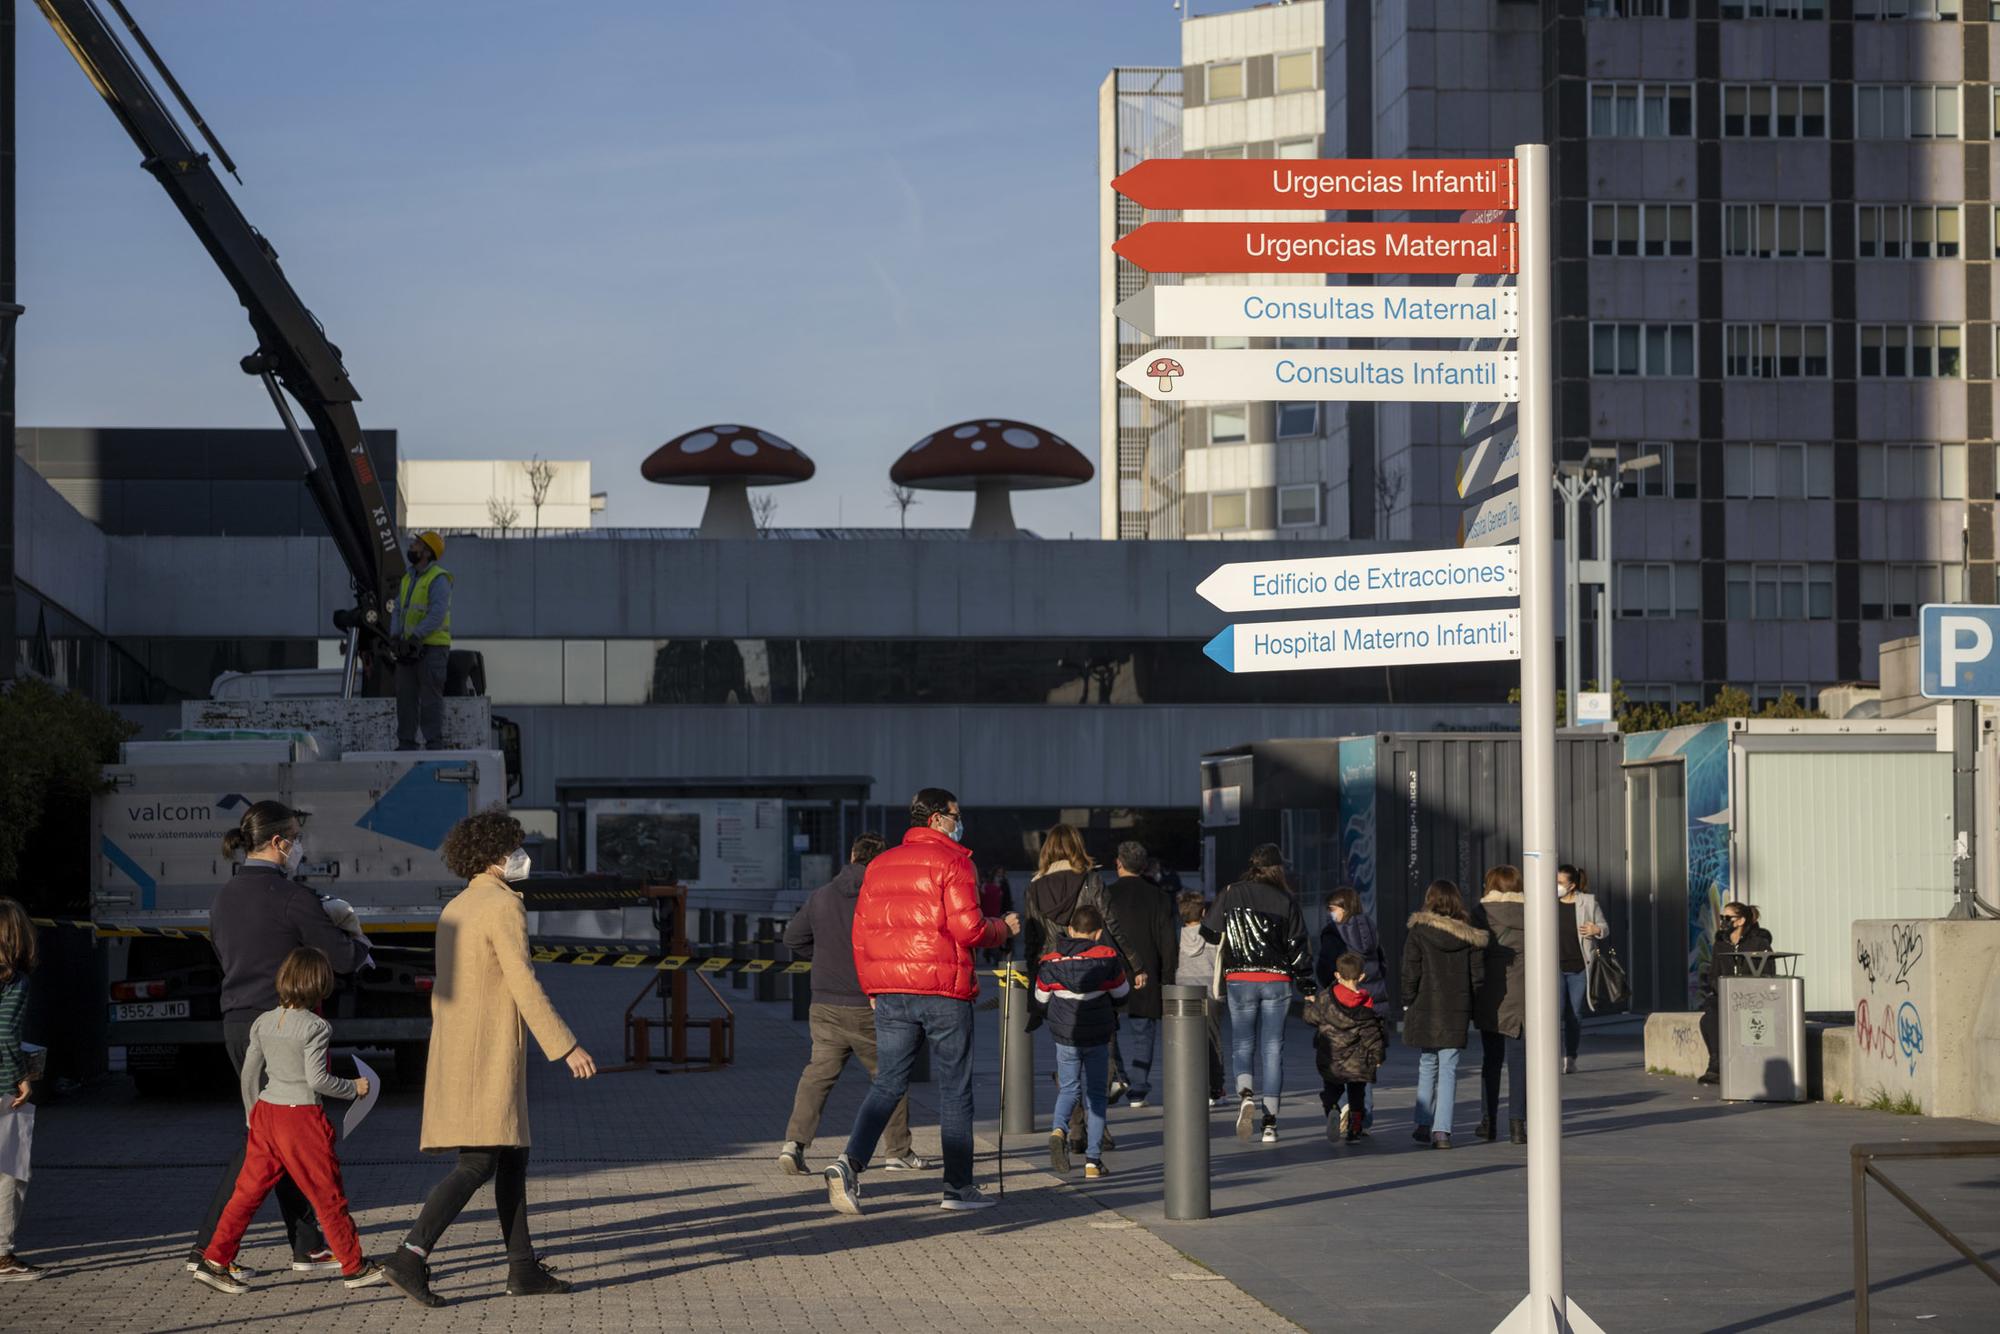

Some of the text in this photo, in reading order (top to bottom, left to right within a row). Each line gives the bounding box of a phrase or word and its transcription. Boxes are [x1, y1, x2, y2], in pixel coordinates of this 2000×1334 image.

[1273, 169, 1497, 198] Urgencias Infantil
[1246, 233, 1498, 262] Urgencias Maternal
[1243, 296, 1496, 320] Consultas Maternal
[1275, 360, 1496, 385] Consultas Infantil
[372, 506, 397, 551] XS 211
[1487, 505, 1508, 533] General
[1252, 561, 1505, 597] Edificio de Extracciones
[1254, 620, 1507, 659] Hospital Materno Infantil
[1940, 615, 1994, 688] P
[128, 802, 211, 822] valcom
[120, 1002, 186, 1019] 3552 JWD
